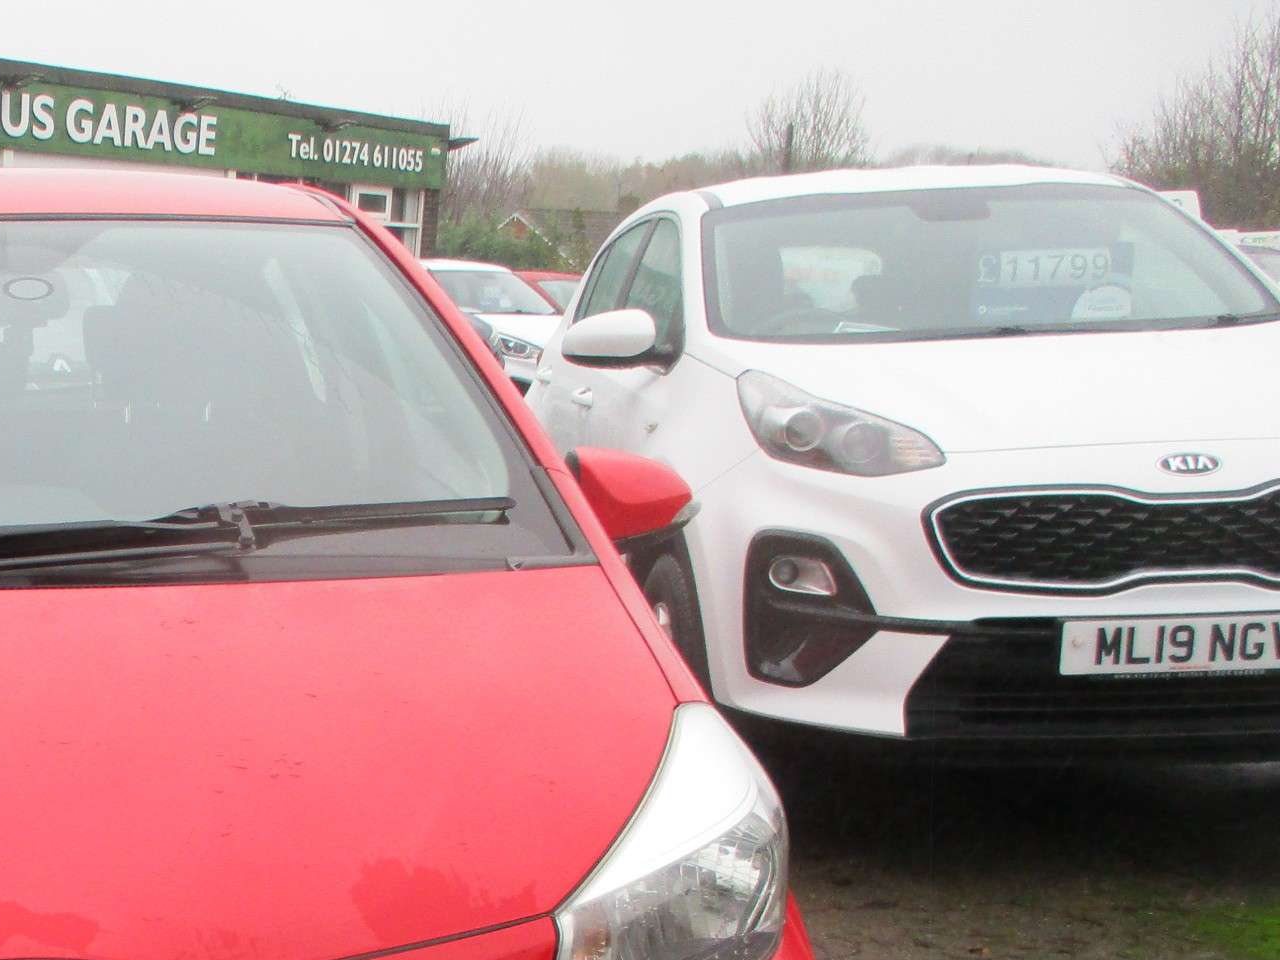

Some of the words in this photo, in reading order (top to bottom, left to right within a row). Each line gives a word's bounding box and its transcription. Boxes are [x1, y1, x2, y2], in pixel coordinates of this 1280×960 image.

[65, 98, 218, 156] GARAGE
[287, 132, 319, 161] Tel.
[322, 138, 370, 167] 01274
[372, 144, 424, 173] 611055
[975, 252, 1110, 283] £11799
[1167, 455, 1214, 471] KIA
[1093, 624, 1196, 666] ML19
